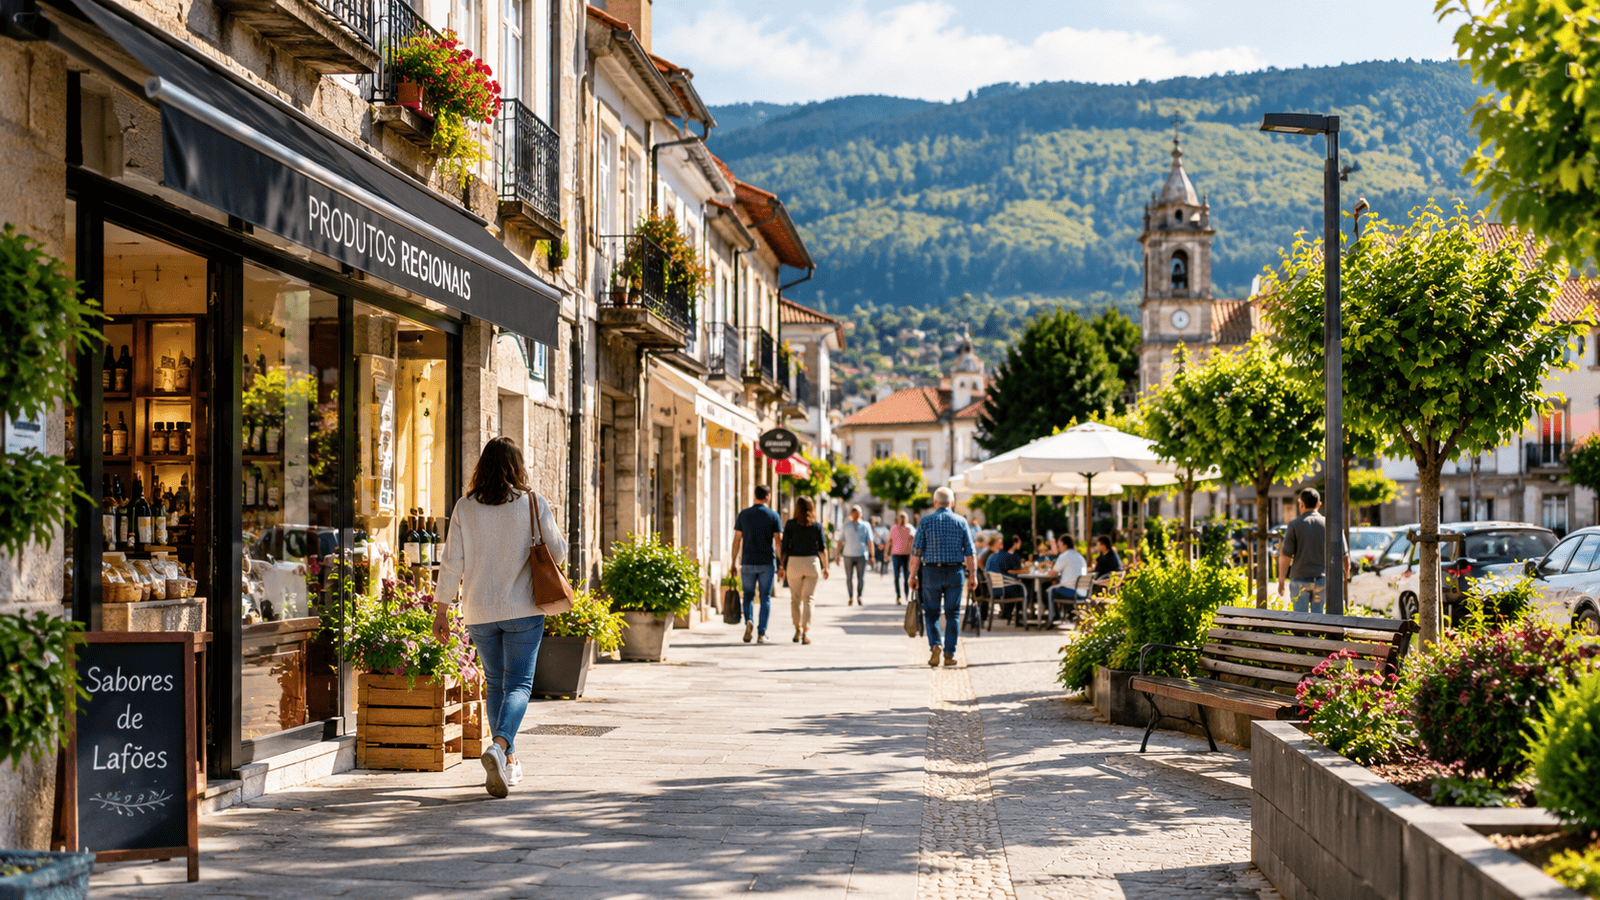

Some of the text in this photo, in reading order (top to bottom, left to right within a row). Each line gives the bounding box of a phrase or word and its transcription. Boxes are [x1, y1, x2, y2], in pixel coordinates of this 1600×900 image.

[308, 195, 472, 301] PRODUTOS REGIONAIS
[85, 666, 174, 693] Sabores
[116, 703, 143, 730] de
[92, 742, 168, 774] Lafões
